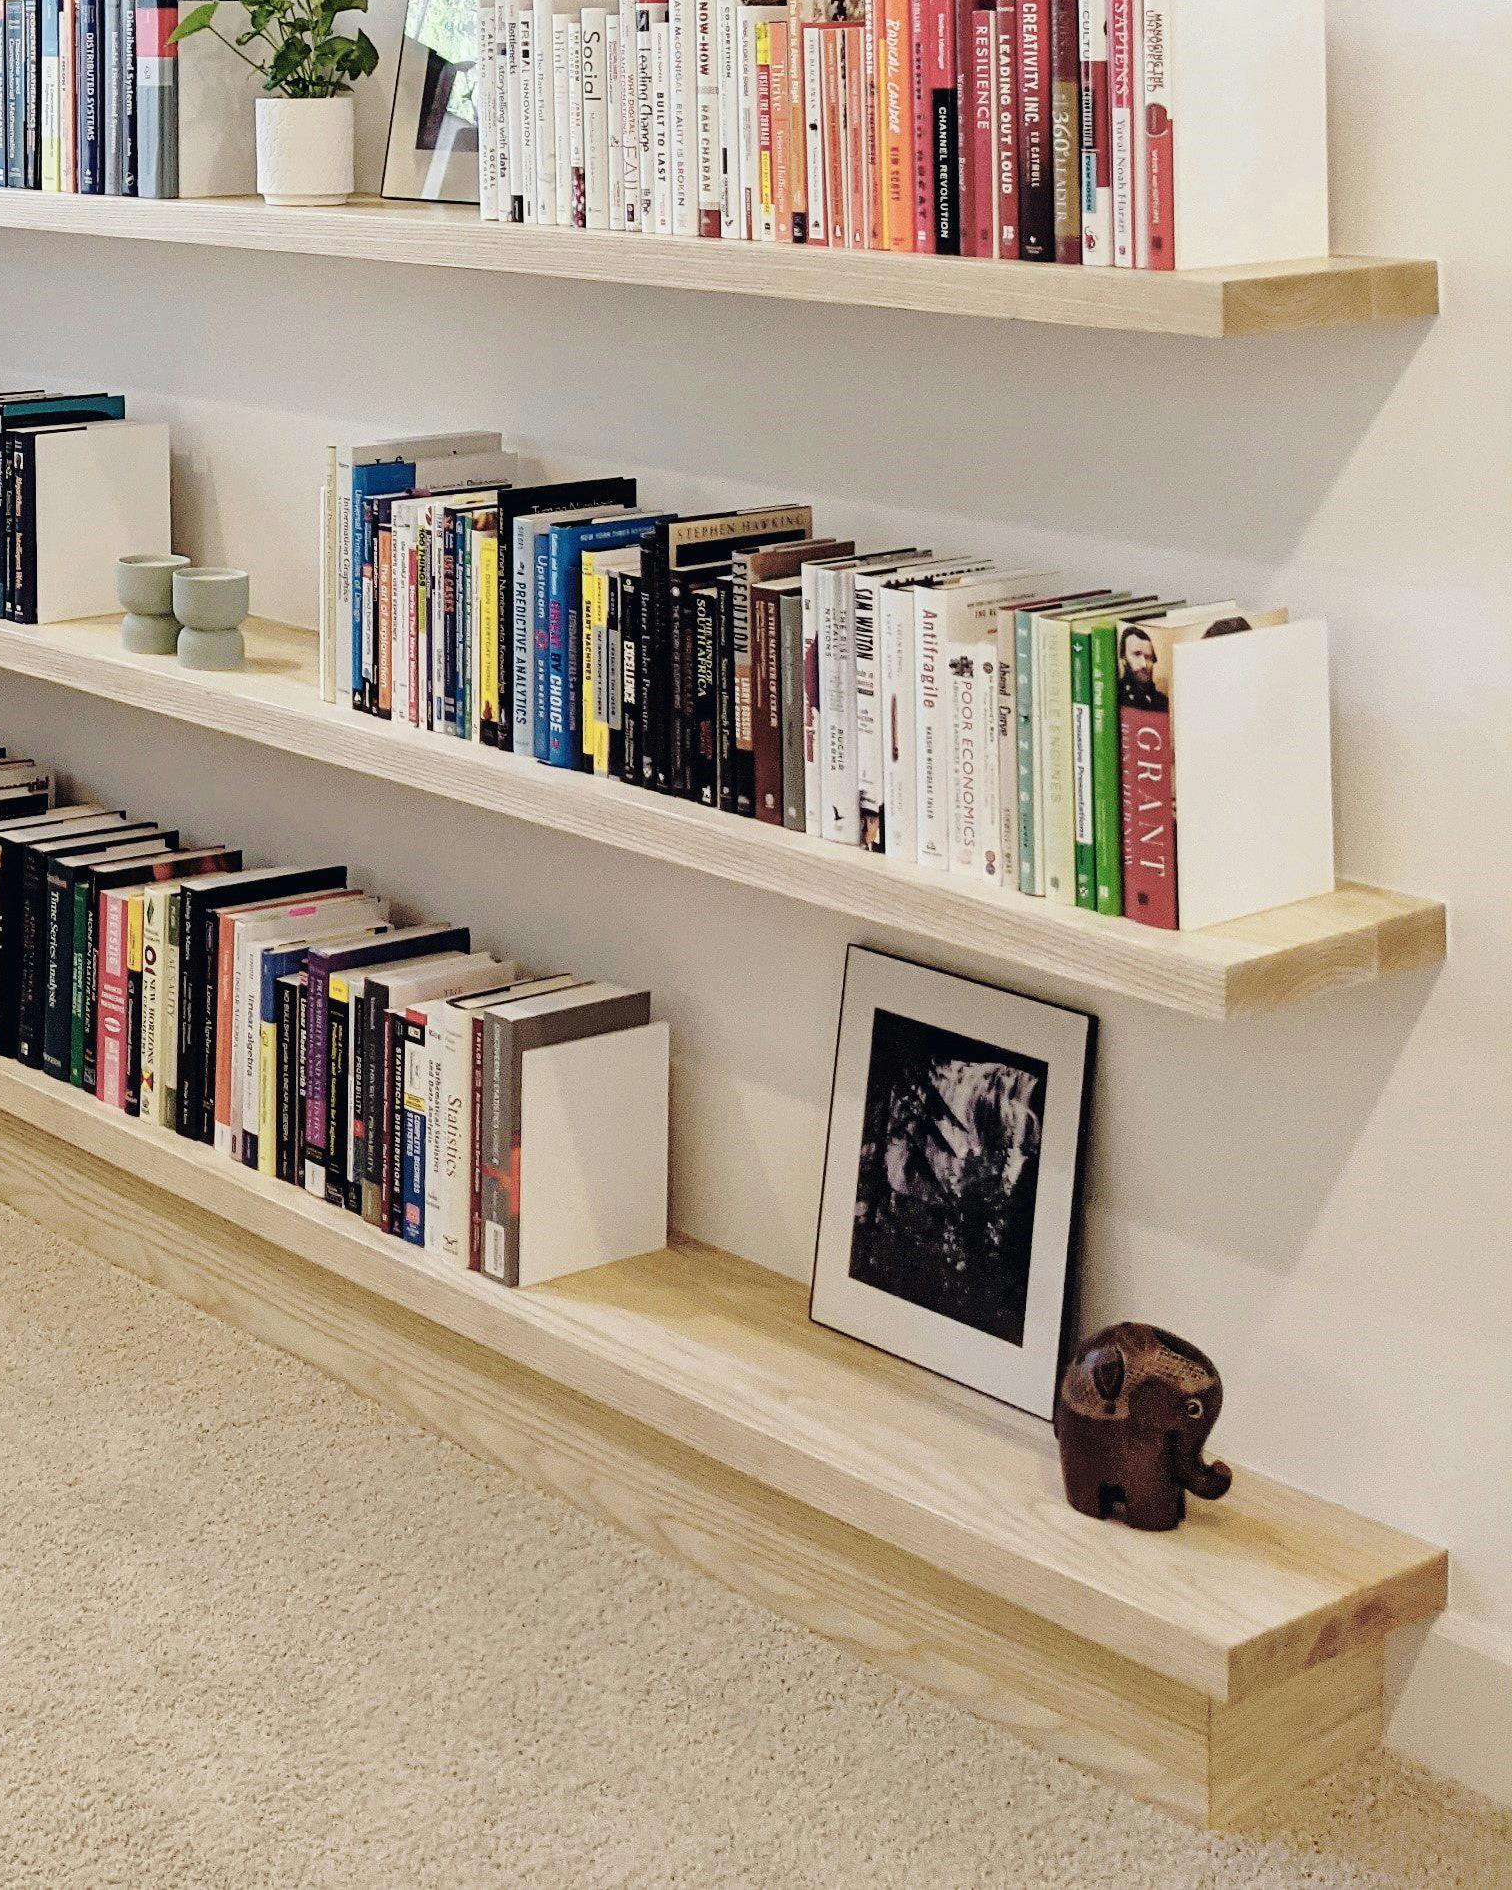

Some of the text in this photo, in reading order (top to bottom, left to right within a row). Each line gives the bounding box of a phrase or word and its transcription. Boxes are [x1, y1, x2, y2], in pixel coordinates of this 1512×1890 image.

[86, 32, 96, 142] DISTRIBUTED SYSTEMS
[125, 11, 135, 116] Distributed Systems
[509, 22, 517, 75] Bottlenecks
[554, 30, 565, 74] blink
[583, 30, 602, 101] Social
[772, 60, 787, 111] Thrive
[888, 19, 901, 135] RADICAL CANDOR
[976, 26, 989, 130] RESILIENCE
[1022, 2, 1040, 126] CREATIVITY, INC.
[1114, 2, 1129, 95] SAPIENS
[1145, 9, 1156, 93] UNEXPECTED
[1154, 13, 1164, 89] MANAGING THE
[496, 65, 509, 178] storytelling with data
[522, 79, 531, 147] INNOVATION
[628, 100, 636, 135] DIGITAL
[638, 48, 653, 153] Leading Change
[657, 92, 668, 182] BUILT TO LAST
[998, 34, 1013, 194] LEADING OUT LOUD
[675, 103, 686, 207] REALITY IS BROKEN
[700, 104, 711, 193] RAM CHARAN
[938, 106, 950, 238] CHANNEL REVOLUTION
[1031, 131, 1041, 187] ED CATMULL
[1116, 118, 1128, 233] Yuval Noah Harari
[418, 528, 426, 586] 100 THINGS
[677, 513, 806, 540] STEPHEN HAWKING
[378, 563, 388, 687] the art of explanation
[537, 555, 548, 619] Upstream
[734, 560, 749, 654] EXECUTION
[854, 588, 874, 661] SAM WALTON
[514, 581, 528, 725] PREDICTIVE ANALYTICS
[550, 651, 563, 733] BY CHOICE
[585, 633, 593, 681] MACHINES
[624, 640, 636, 704] EXCELLENCE
[696, 598, 708, 698] SOUTH AFRICA
[705, 616, 713, 685] THE MIND OF
[920, 609, 938, 709] Antifragile
[962, 681, 976, 848] POOR ECONOMICS
[1076, 707, 1085, 840] Persuasive Presentations
[1136, 726, 1166, 878] GRANT
[48, 891, 60, 1009] Time Series Analysis
[146, 978, 157, 1064] NEW HORIZONS
[245, 993, 255, 1077] linear algebra
[393, 1047, 402, 1193] STATISTICAL DISTRIBUTIONS
[406, 1112, 414, 1157] STATISTICS
[413, 1114, 421, 1195] COMPLETE BUSINESS
[426, 1098, 434, 1143] Analysis
[432, 1062, 442, 1174] Mathematical Statistics
[445, 1094, 462, 1179] Statistics
